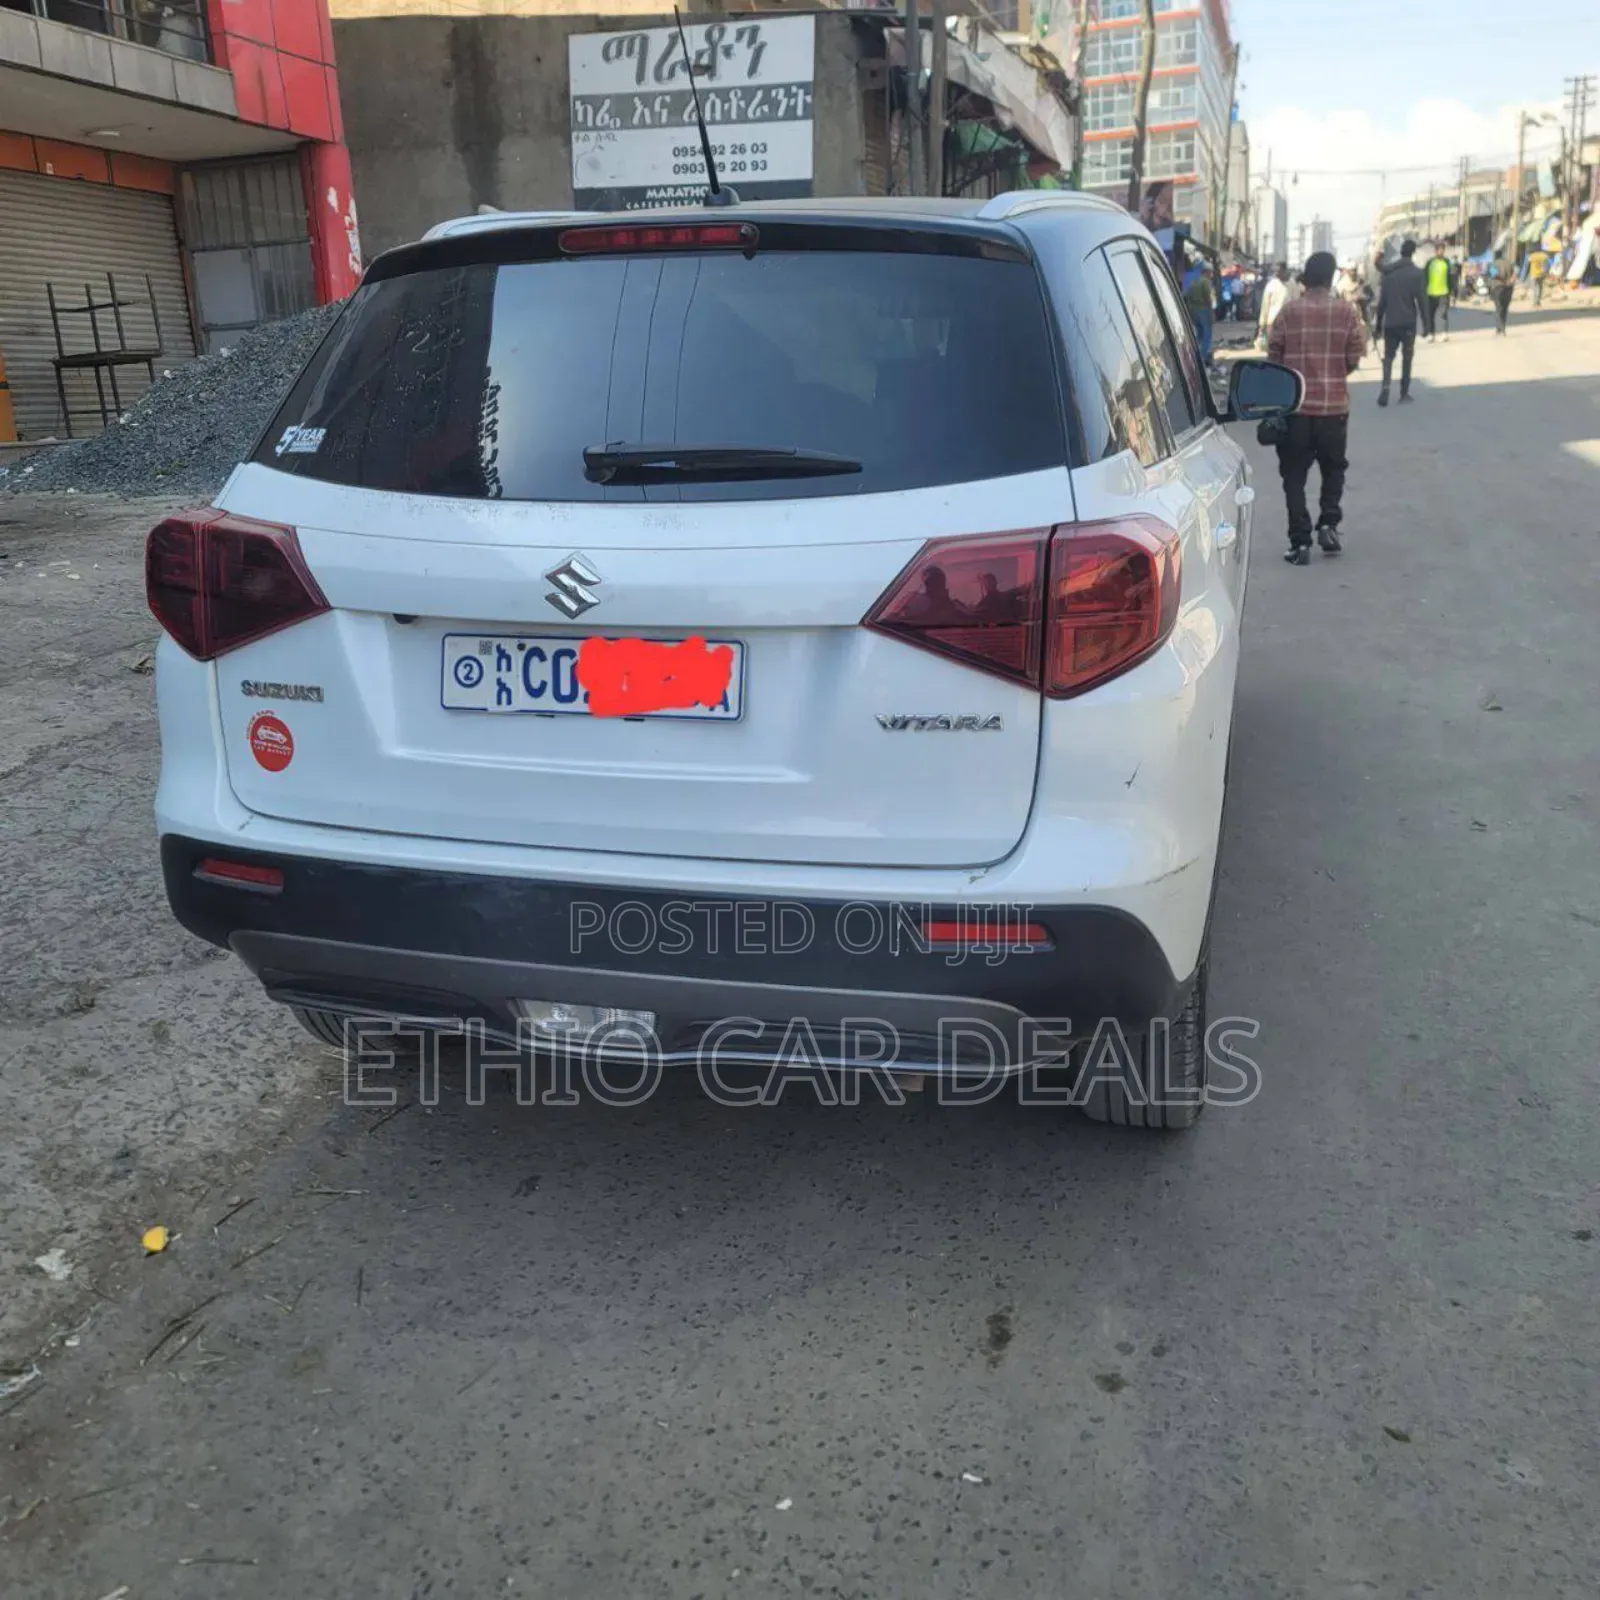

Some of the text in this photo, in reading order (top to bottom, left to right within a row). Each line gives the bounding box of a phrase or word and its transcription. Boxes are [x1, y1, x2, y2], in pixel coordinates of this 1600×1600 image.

[575, 98, 621, 128] ካፌ
[632, 96, 671, 126] እና
[709, 144, 726, 156] 92
[730, 143, 747, 155] 26
[750, 142, 768, 154] 03
[672, 159, 768, 175] 0903 9 20 93
[645, 185, 711, 199] MARATHO
[296, 428, 327, 441] YEAR
[240, 679, 325, 703] SUZUKI
[873, 712, 1005, 732] VITARA
